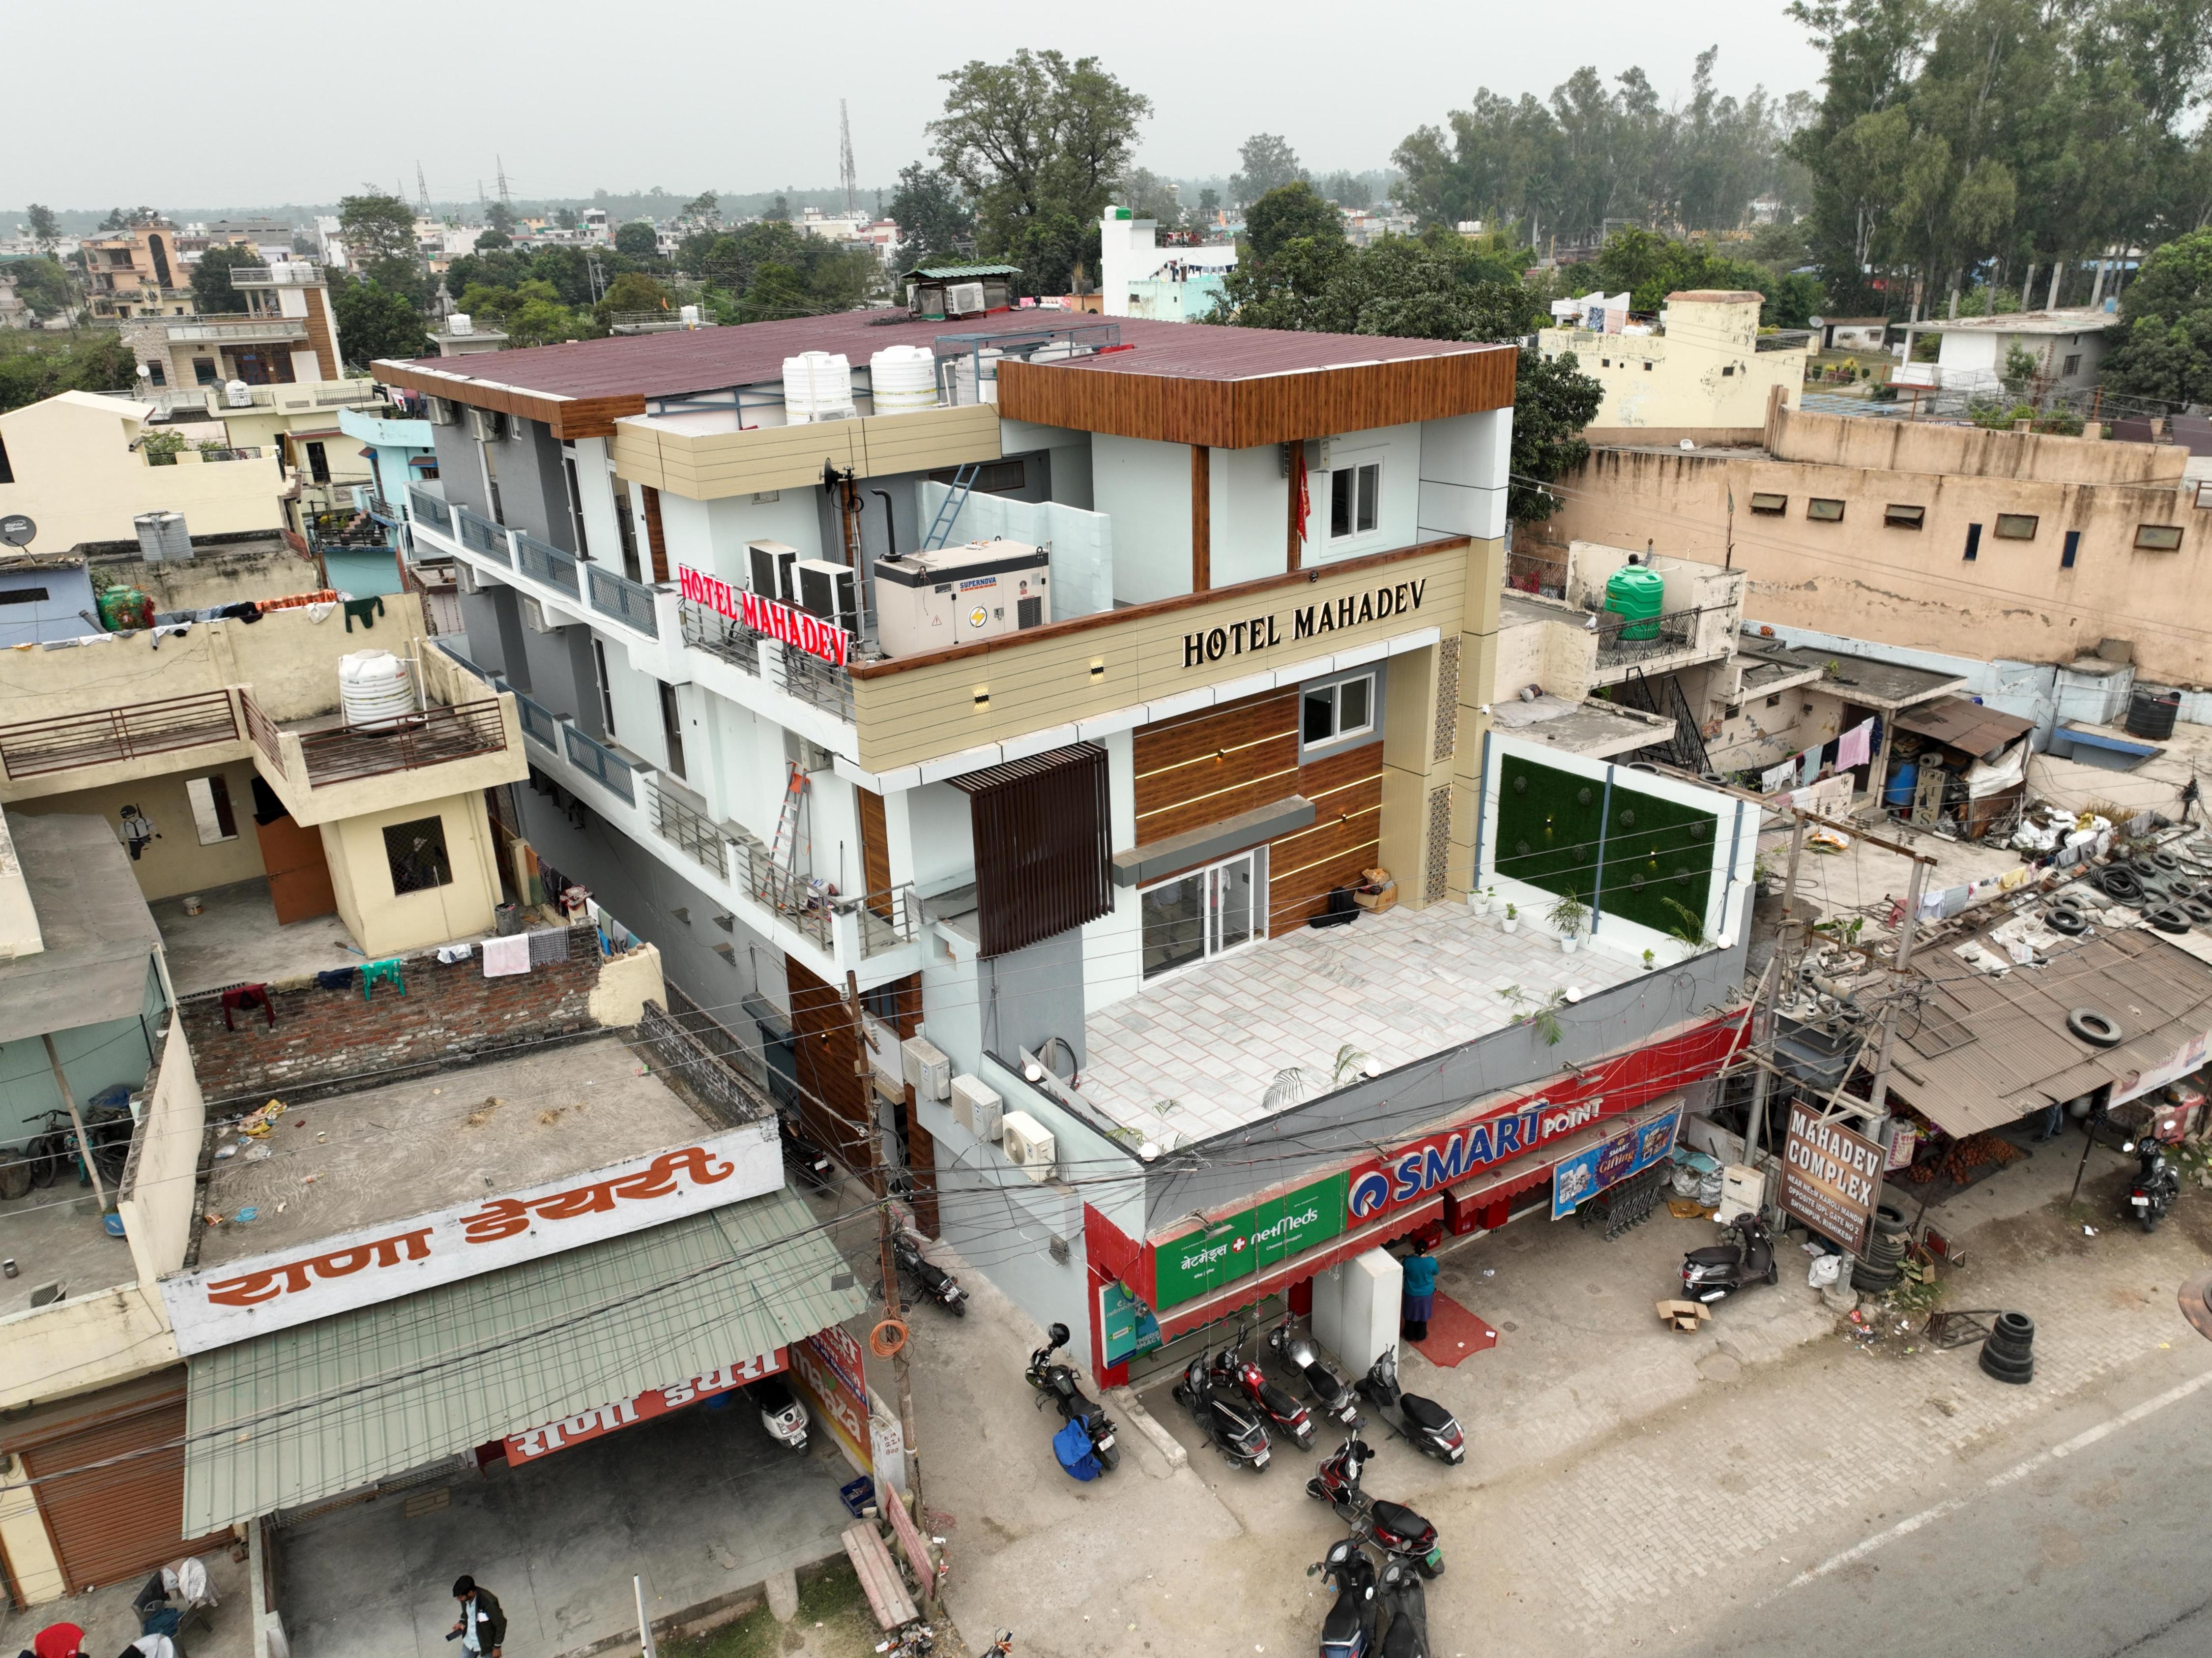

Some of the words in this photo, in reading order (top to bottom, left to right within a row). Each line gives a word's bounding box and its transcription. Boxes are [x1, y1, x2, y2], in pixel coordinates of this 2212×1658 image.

[960, 577, 996, 589] SUPERNOVA
[679, 565, 740, 622] HOTEL
[742, 591, 849, 666] MAHADEV
[1181, 614, 1281, 668] HOTEL
[1291, 578, 1426, 641] MAHADEV
[1393, 1097, 1549, 1202] SMART
[1542, 1098, 1603, 1139] POINT
[1600, 1151, 1633, 1173] Gifting
[1608, 1143, 1630, 1157] SMART
[1791, 1110, 1878, 1178] MAHADEV
[1788, 1140, 1872, 1207] COMPLEX
[1787, 1174, 1803, 1188] NEAR
[1803, 1184, 1819, 1198] NEEM
[1819, 1193, 1840, 1211] KAROLI
[1841, 1207, 1863, 1226] MANDIR
[1788, 1186, 1815, 1207] OPPOSITE
[1816, 1199, 1828, 1216] IDPL
[1830, 1212, 1844, 1225] GATE
[1845, 1221, 1854, 1232] NO
[1791, 1199, 1821, 1224] SHYAMPUR,
[1823, 1218, 1853, 1243] RISHIKESH
[206, 1227, 434, 1306] राणा
[459, 1147, 734, 1244] डेयरी
[1266, 1241, 1283, 1251] Chemist
[1285, 1233, 1303, 1244] Druggist
[1181, 1244, 1228, 1271] नेटमेड्स
[1136, 1335, 1161, 1350] RMACY
[791, 1346, 861, 1443] maaza
[508, 1395, 640, 1457] राणा
[885, 1437, 900, 1448] 221
